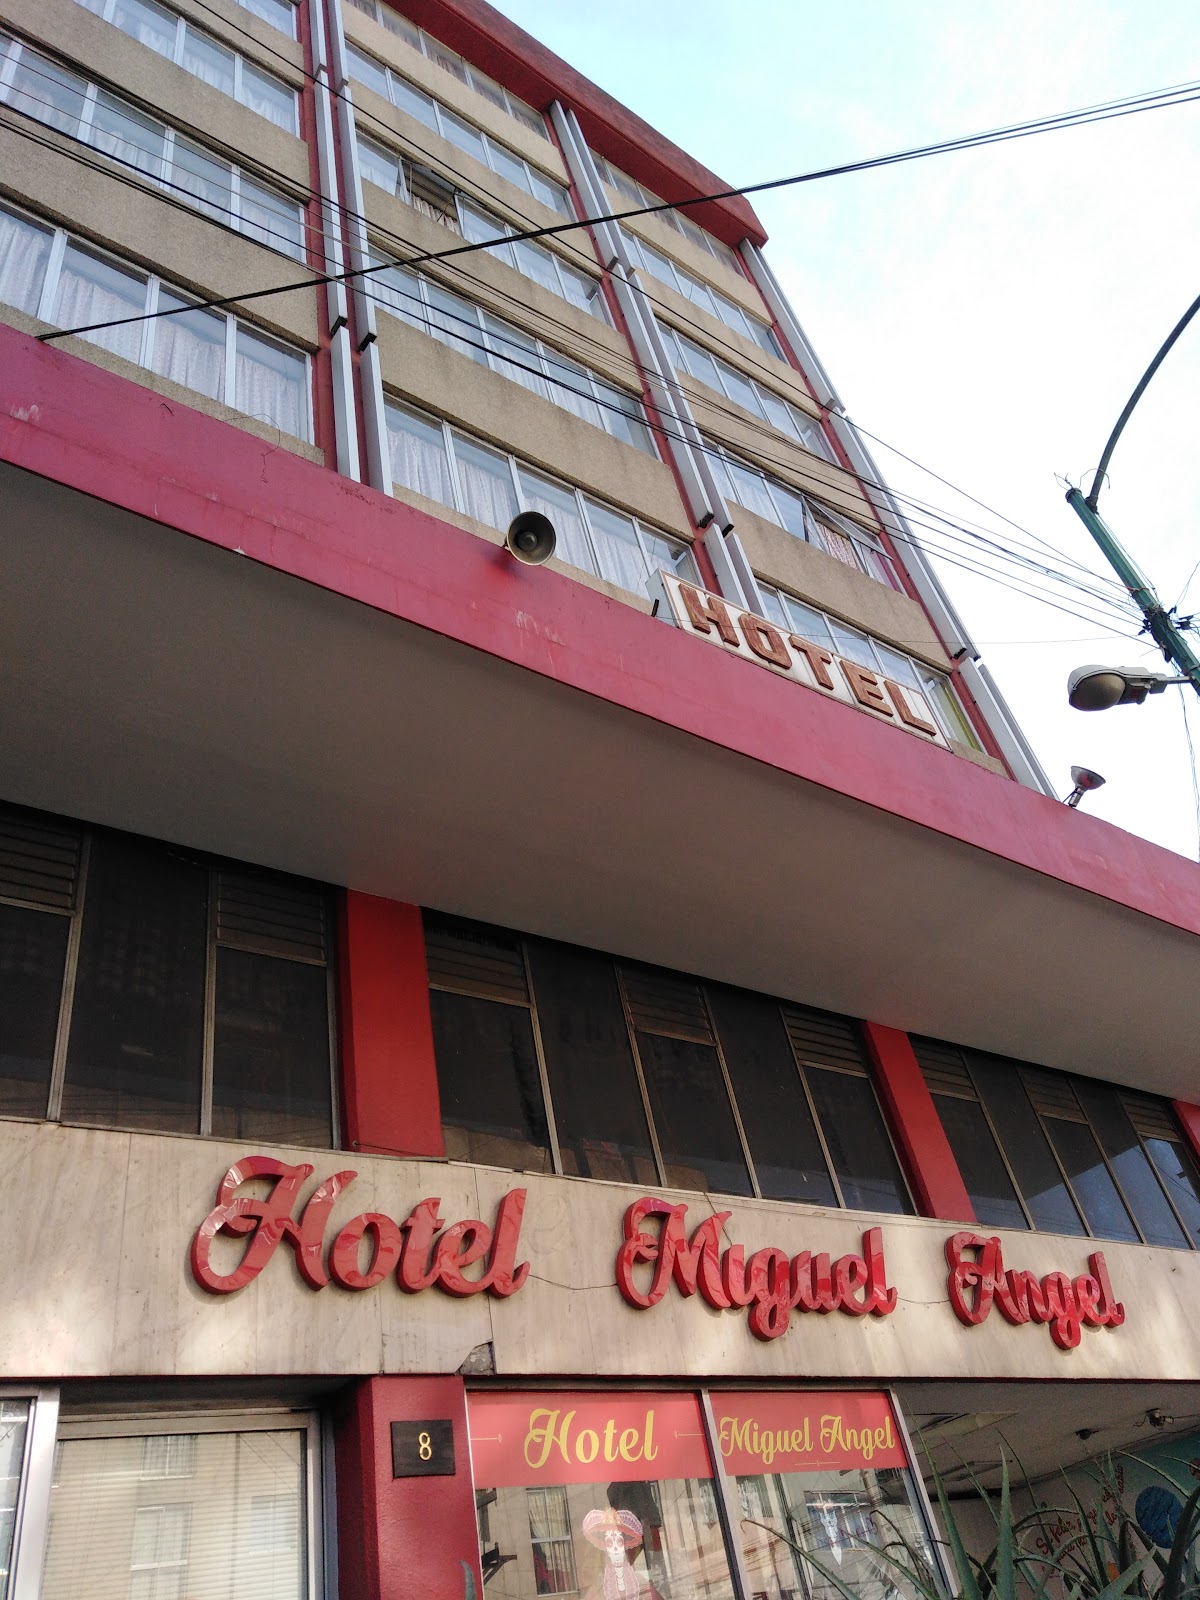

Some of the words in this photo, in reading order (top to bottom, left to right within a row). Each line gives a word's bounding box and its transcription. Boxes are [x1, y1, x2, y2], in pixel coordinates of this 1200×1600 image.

[678, 583, 937, 736] HOTEL
[191, 1156, 531, 1298] Hotel
[616, 1197, 898, 1341] Miguel
[944, 1231, 1125, 1350] Angel
[418, 1432, 432, 1460] 8
[523, 1408, 658, 1469] Hotel
[719, 1416, 813, 1464] Miguel
[820, 1415, 895, 1460] Angel
